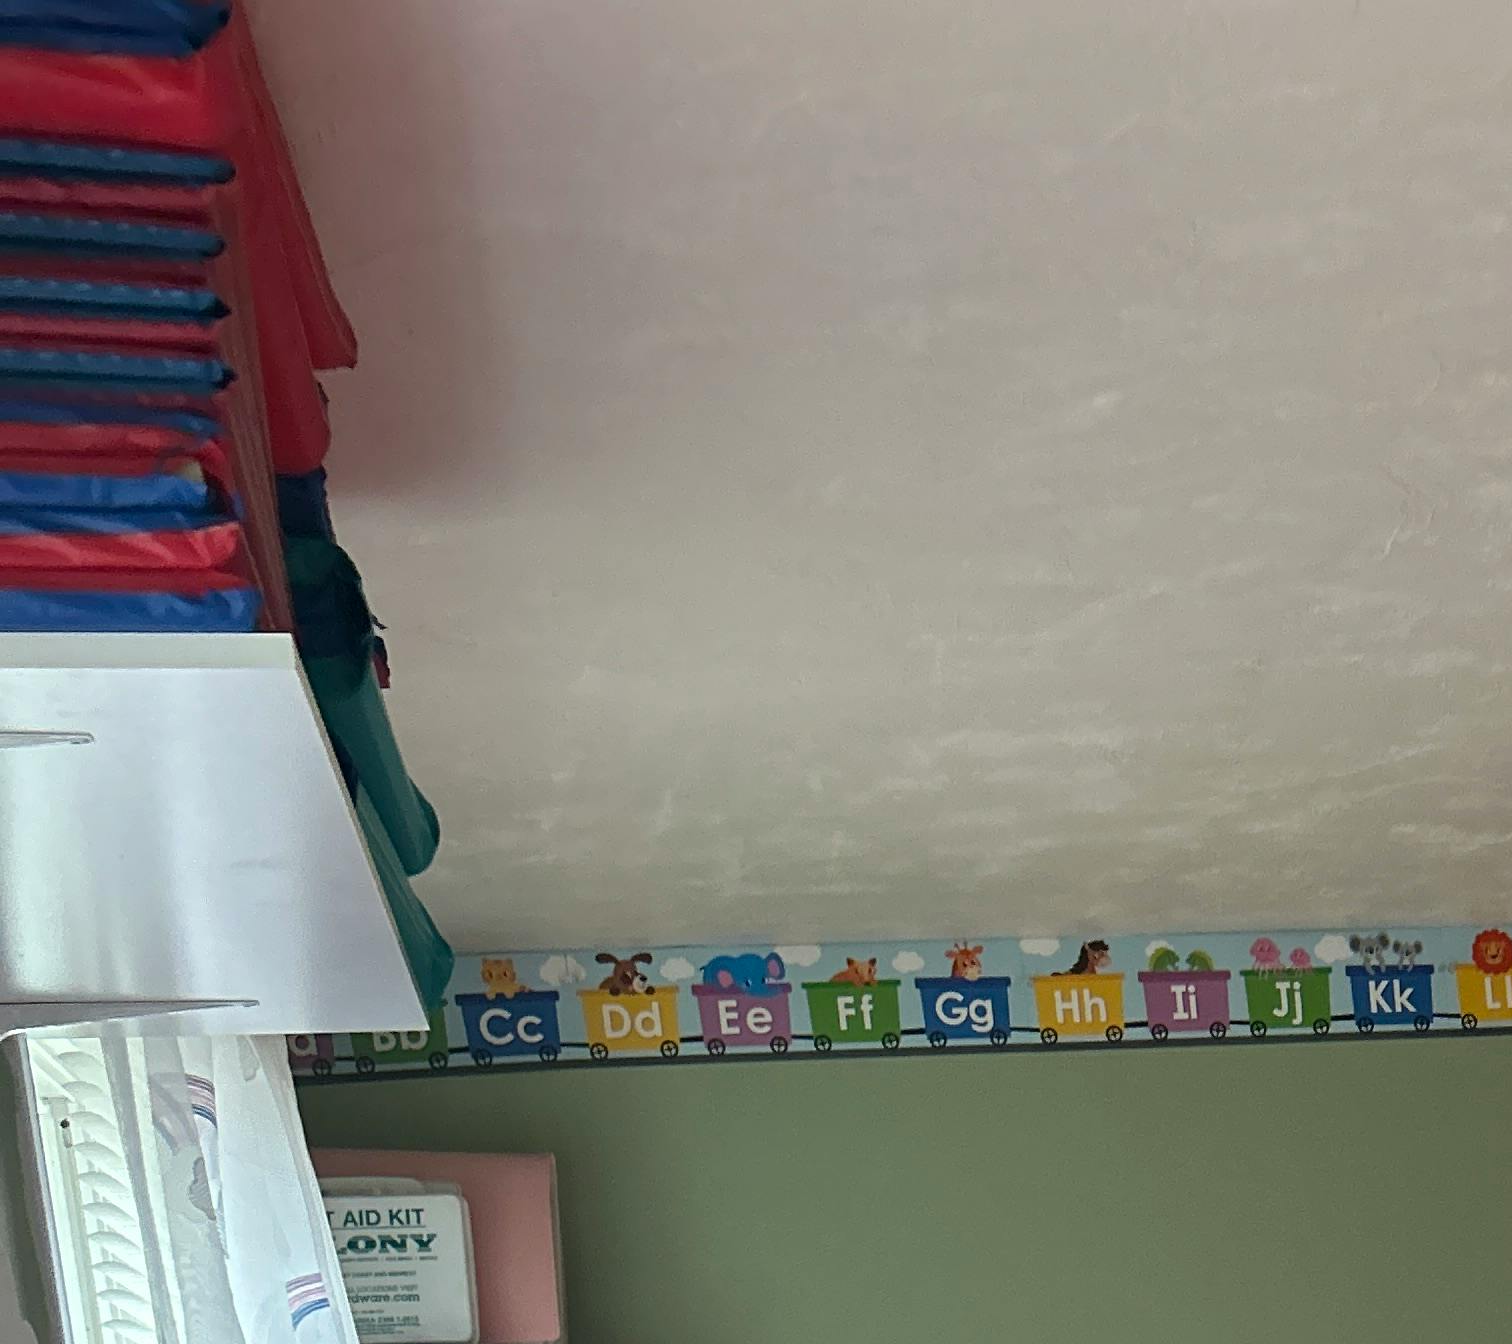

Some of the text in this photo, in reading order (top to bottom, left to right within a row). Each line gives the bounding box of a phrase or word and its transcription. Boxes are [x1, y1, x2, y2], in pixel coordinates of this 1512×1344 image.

[837, 994, 875, 1031] Ff
[935, 991, 997, 1034] Gg
[1054, 990, 1108, 1025] Hh
[1170, 984, 1197, 1021] Ii
[1272, 983, 1303, 1026] Jj
[1368, 979, 1417, 1014] Kk
[478, 1007, 545, 1046] Cc
[602, 999, 663, 1041] Dd
[717, 1000, 774, 1034] Ee
[343, 1208, 381, 1227] AID
[388, 1208, 424, 1226] KIT
[333, 1233, 437, 1254] ONY
